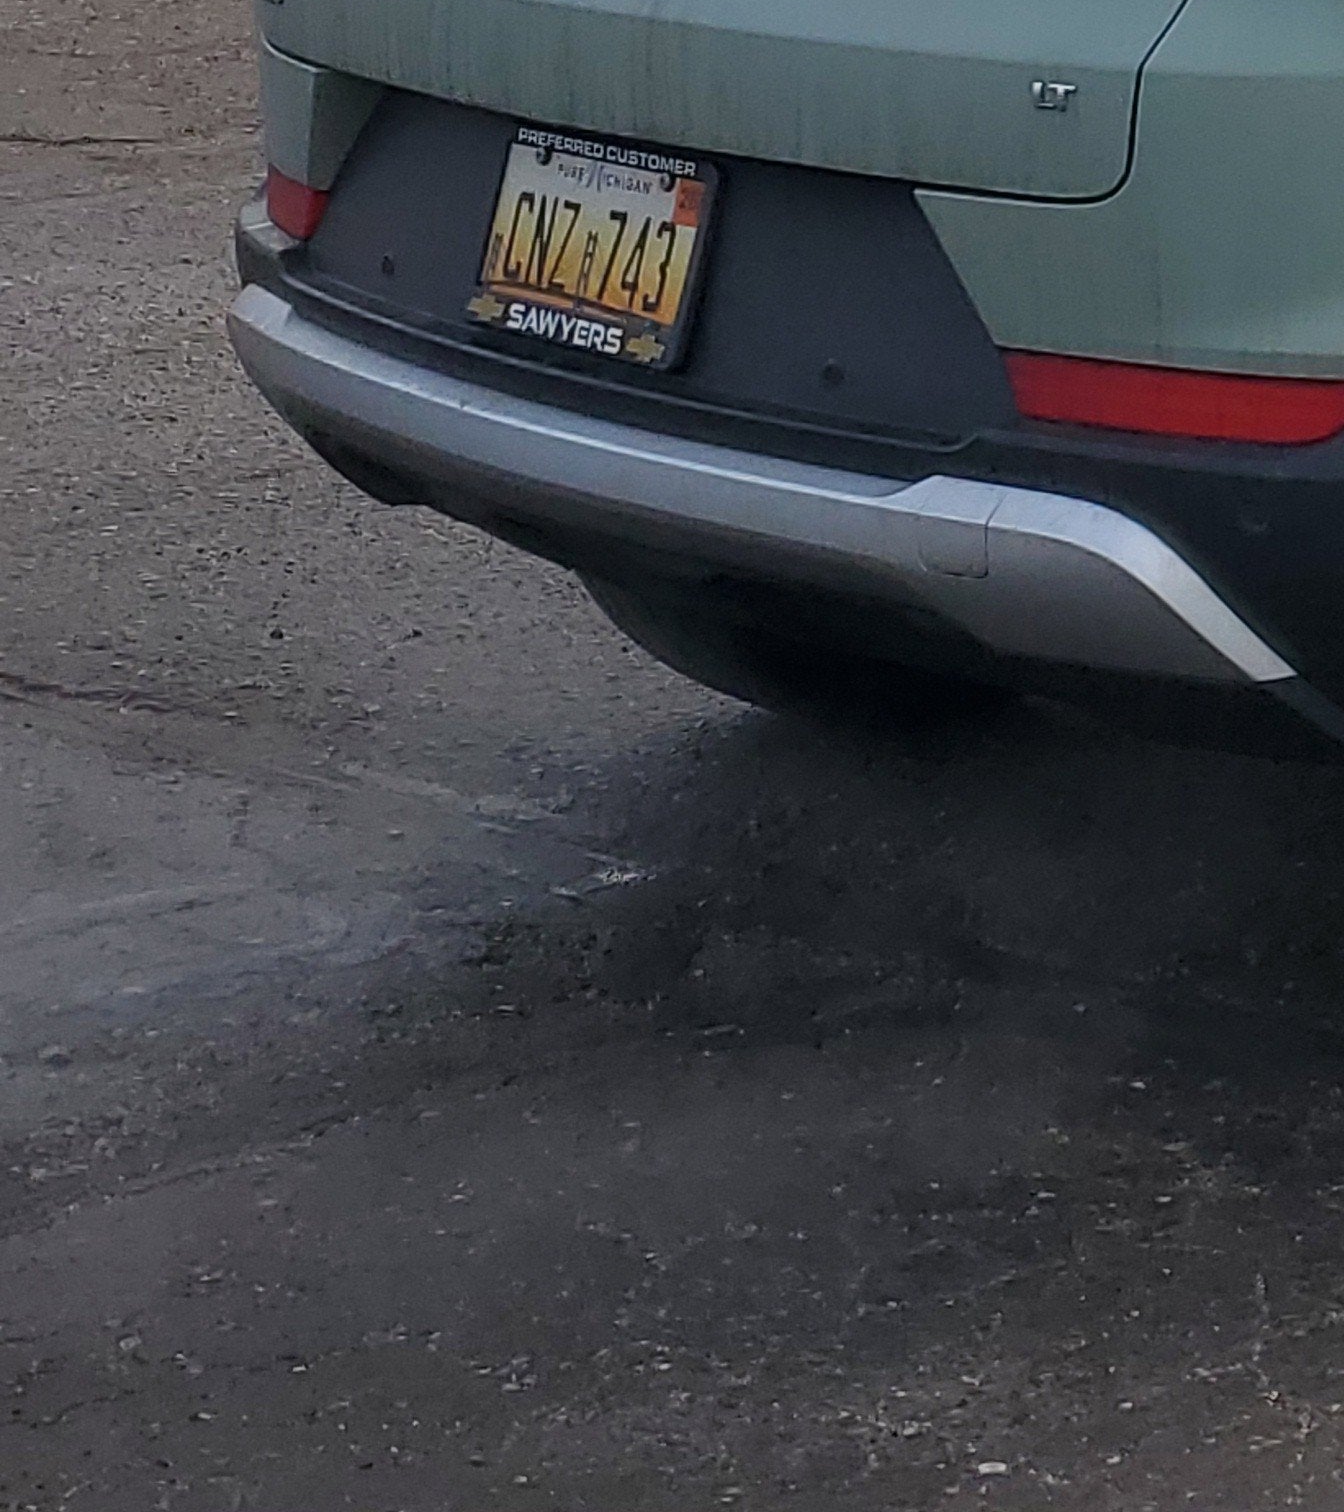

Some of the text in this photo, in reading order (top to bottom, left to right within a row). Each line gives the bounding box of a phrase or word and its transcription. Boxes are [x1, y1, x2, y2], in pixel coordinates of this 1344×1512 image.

[1031, 80, 1077, 111] LT
[518, 127, 696, 177] PREFERRED CUSTOMER
[502, 190, 678, 313] CNZ 743
[506, 303, 624, 355] SAWYERS
